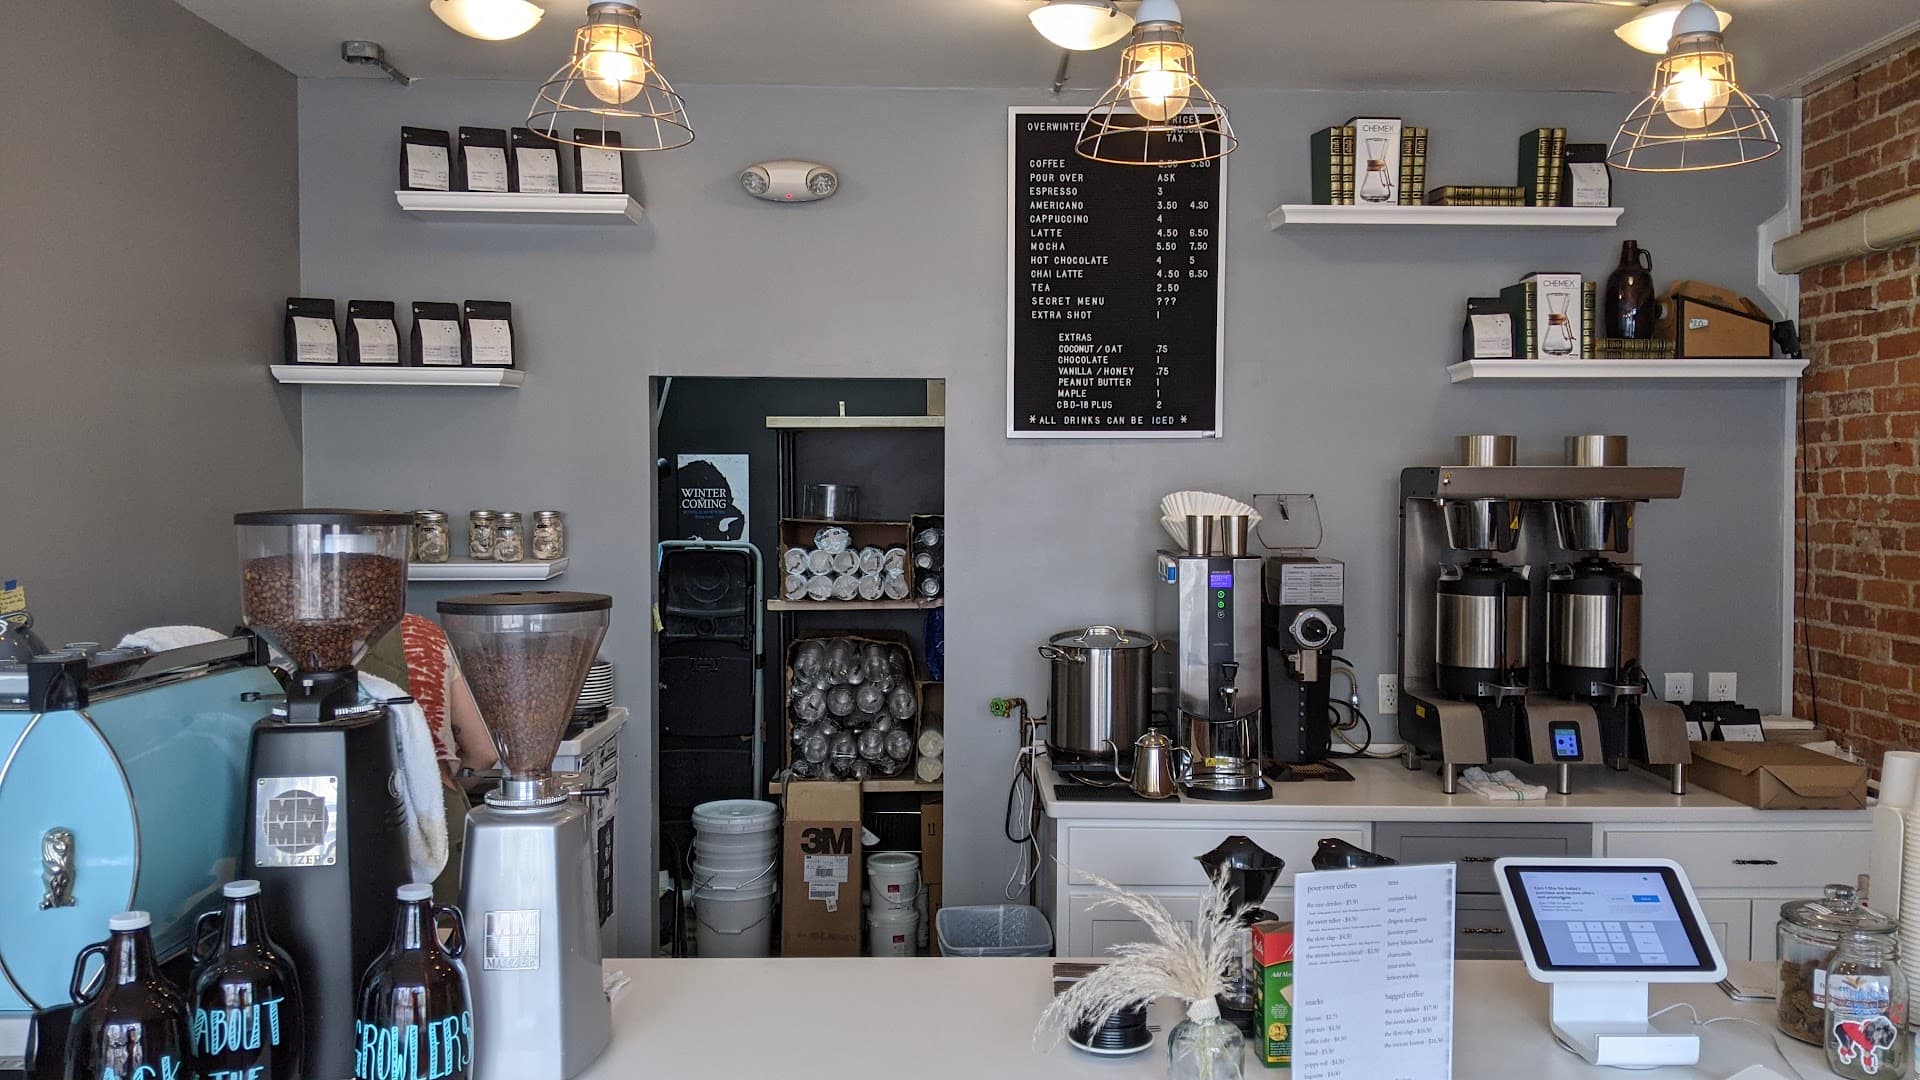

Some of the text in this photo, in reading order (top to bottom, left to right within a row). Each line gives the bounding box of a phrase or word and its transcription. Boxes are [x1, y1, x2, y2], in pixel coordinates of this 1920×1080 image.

[1362, 124, 1394, 132] CHEMEX
[1167, 134, 1184, 143] TAX
[1030, 159, 1065, 168] COFFEE
[1030, 173, 1175, 182] POUR OVER ASK
[1030, 187, 1163, 195] ESPRESSO 3
[1030, 201, 1083, 209] AMERICANO
[1157, 201, 1177, 209] 3.50
[1030, 214, 1088, 223] CAPPUCCINO
[1031, 229, 1208, 237] LATTE 4.50 6.50
[1031, 242, 1207, 250] MOCHA 5.50 7.50
[1031, 256, 1194, 264] HOT CHOCOLATE 4 5
[1031, 269, 1208, 278] CHAI LATTE 4.50 6.50
[1032, 283, 1179, 292] TEA 2.50
[1543, 280, 1575, 288] CHEMEX
[1032, 297, 1070, 305] SECRET
[1078, 297, 1104, 306] MENU
[1032, 311, 1061, 319] EXTRA
[1067, 311, 1092, 319] SHOT
[1059, 333, 1091, 341] EXTRAS
[1059, 345, 1094, 353] COCONUT
[1105, 345, 1122, 353] OAT
[1156, 345, 1167, 353] .75
[1058, 356, 1108, 364] CHOCOLATE
[1059, 367, 1092, 375] VANILLA
[1156, 367, 1168, 375] .75
[1059, 378, 1094, 386] PEANUT
[1098, 378, 1131, 386] BUTTER
[1092, 401, 1112, 409] PLUS
[1064, 416, 1100, 424] DRINKS
[1131, 416, 1143, 424] BE
[1152, 416, 1174, 424] ICED
[681, 488, 726, 497] WINTER
[682, 499, 726, 508] COMING
[801, 828, 852, 854] 3M
[193, 997, 284, 1055] ABOUT
